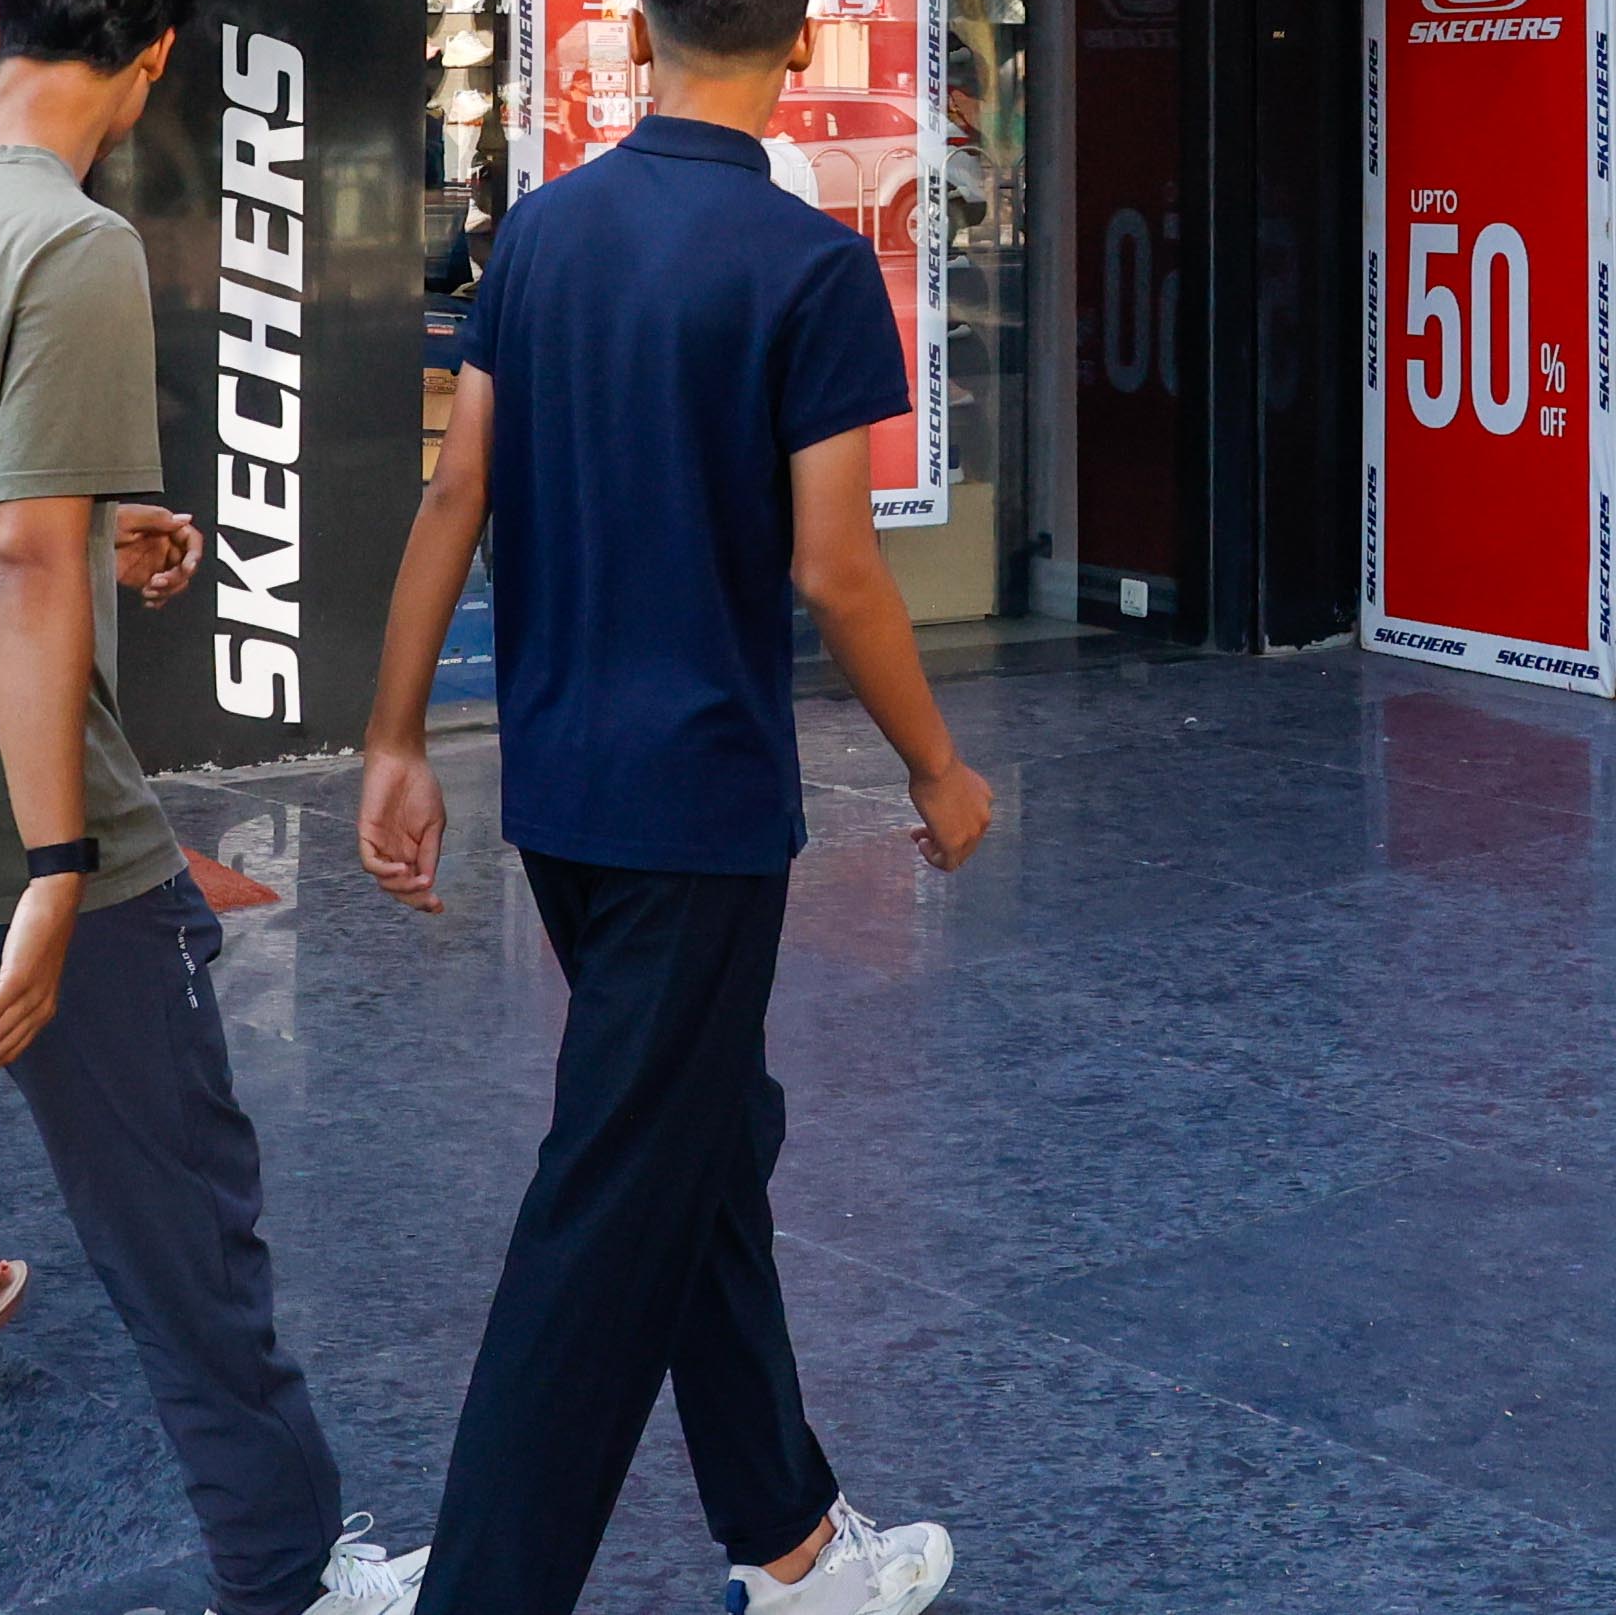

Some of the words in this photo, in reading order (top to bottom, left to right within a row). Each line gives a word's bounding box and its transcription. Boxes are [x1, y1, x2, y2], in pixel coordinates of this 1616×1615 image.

[1408, 16, 1562, 44] SKECHERS
[1368, 38, 1379, 178] SKECHERS
[1595, 31, 1608, 183] SKECHERS
[1411, 190, 1458, 214] UPTO
[214, 22, 305, 724] SKECHERS
[1367, 249, 1379, 391] SKECHERS
[1407, 222, 1530, 436] 50
[1541, 342, 1565, 393] %
[1598, 260, 1610, 414] SKECHERS
[929, 342, 941, 488] SKECHERS
[1540, 407, 1567, 438] OFF
[872, 500, 935, 516] HERS
[1367, 462, 1379, 607] SKECHERS
[1598, 491, 1610, 644] SKECHERS
[1374, 627, 1466, 658] SKECHERS
[1497, 649, 1600, 680] SKECHERS
